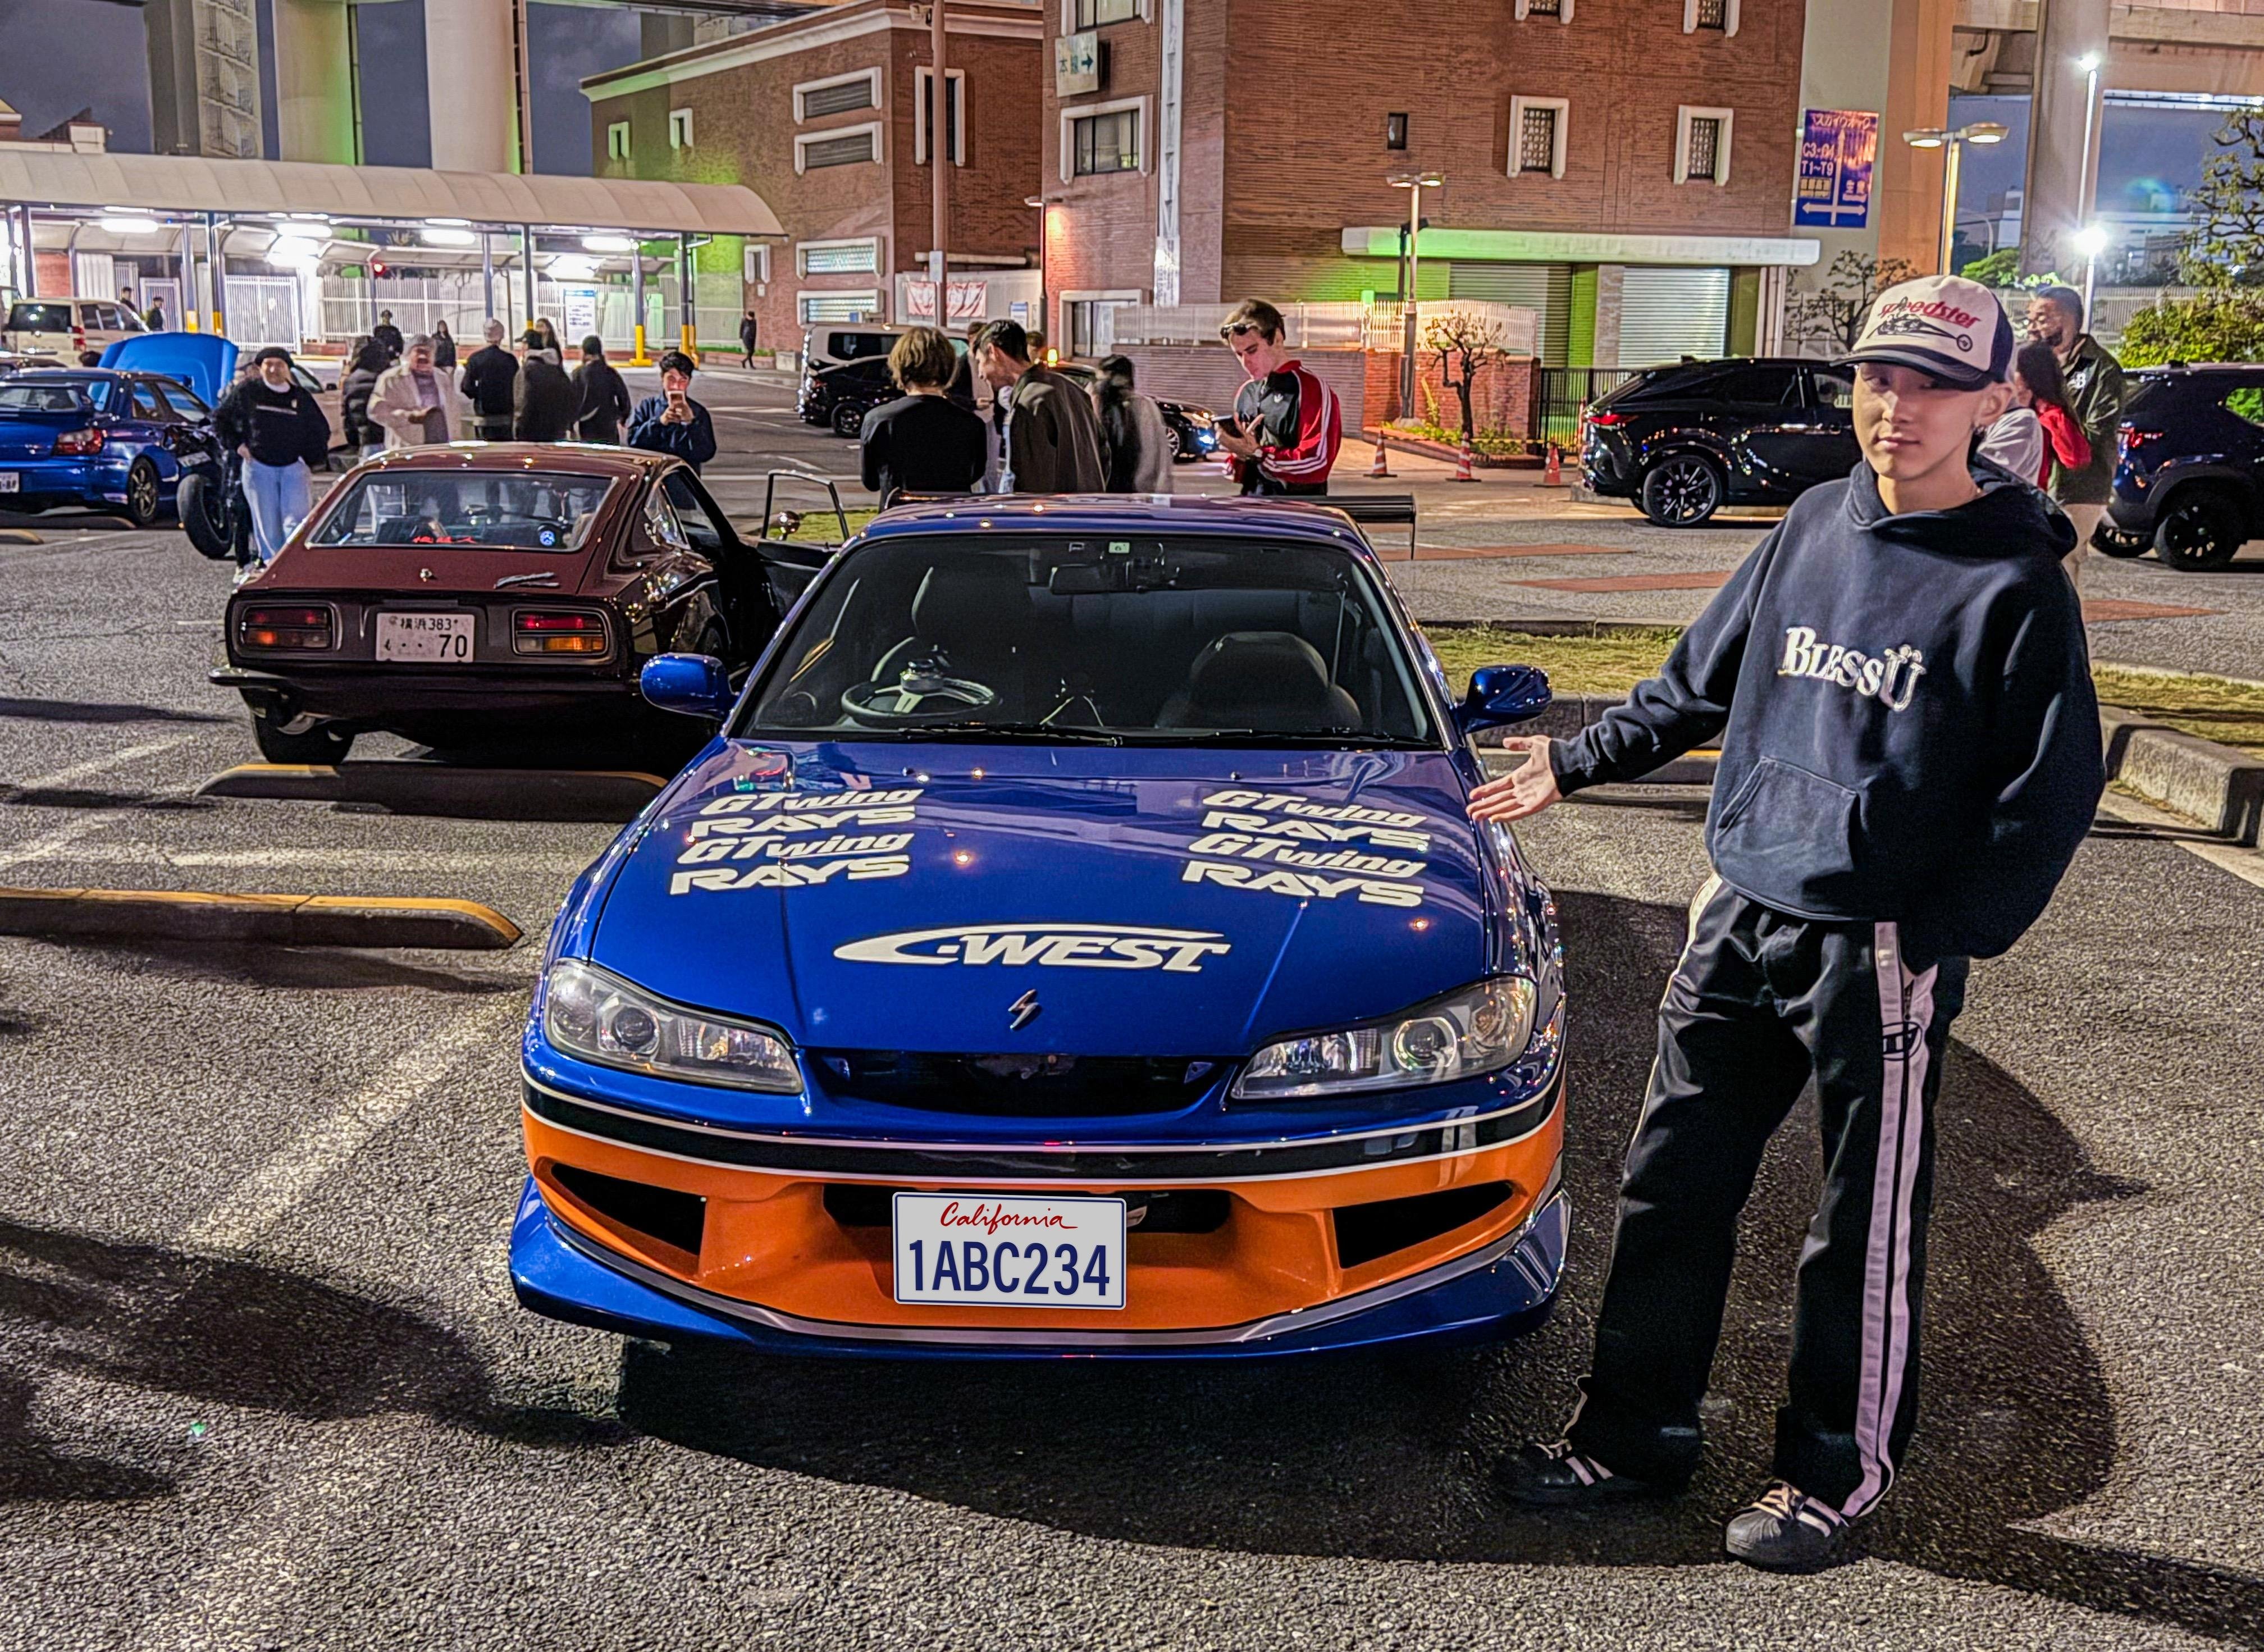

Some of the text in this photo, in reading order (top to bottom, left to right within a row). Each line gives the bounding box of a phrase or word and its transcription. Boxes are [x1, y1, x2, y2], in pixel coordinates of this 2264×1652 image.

[699, 788, 925, 815] GTwing
[1202, 790, 1428, 828] GTwing
[691, 805, 916, 837] RAYS
[1201, 811, 1431, 850] RAYS
[677, 833, 915, 864] GTwing
[1188, 832, 1427, 878] GTwing
[669, 855, 910, 896] RAYS
[1182, 860, 1425, 907] RAYS
[940, 1202, 1079, 1235] California
[909, 1239, 1111, 1296] 1ABC234
